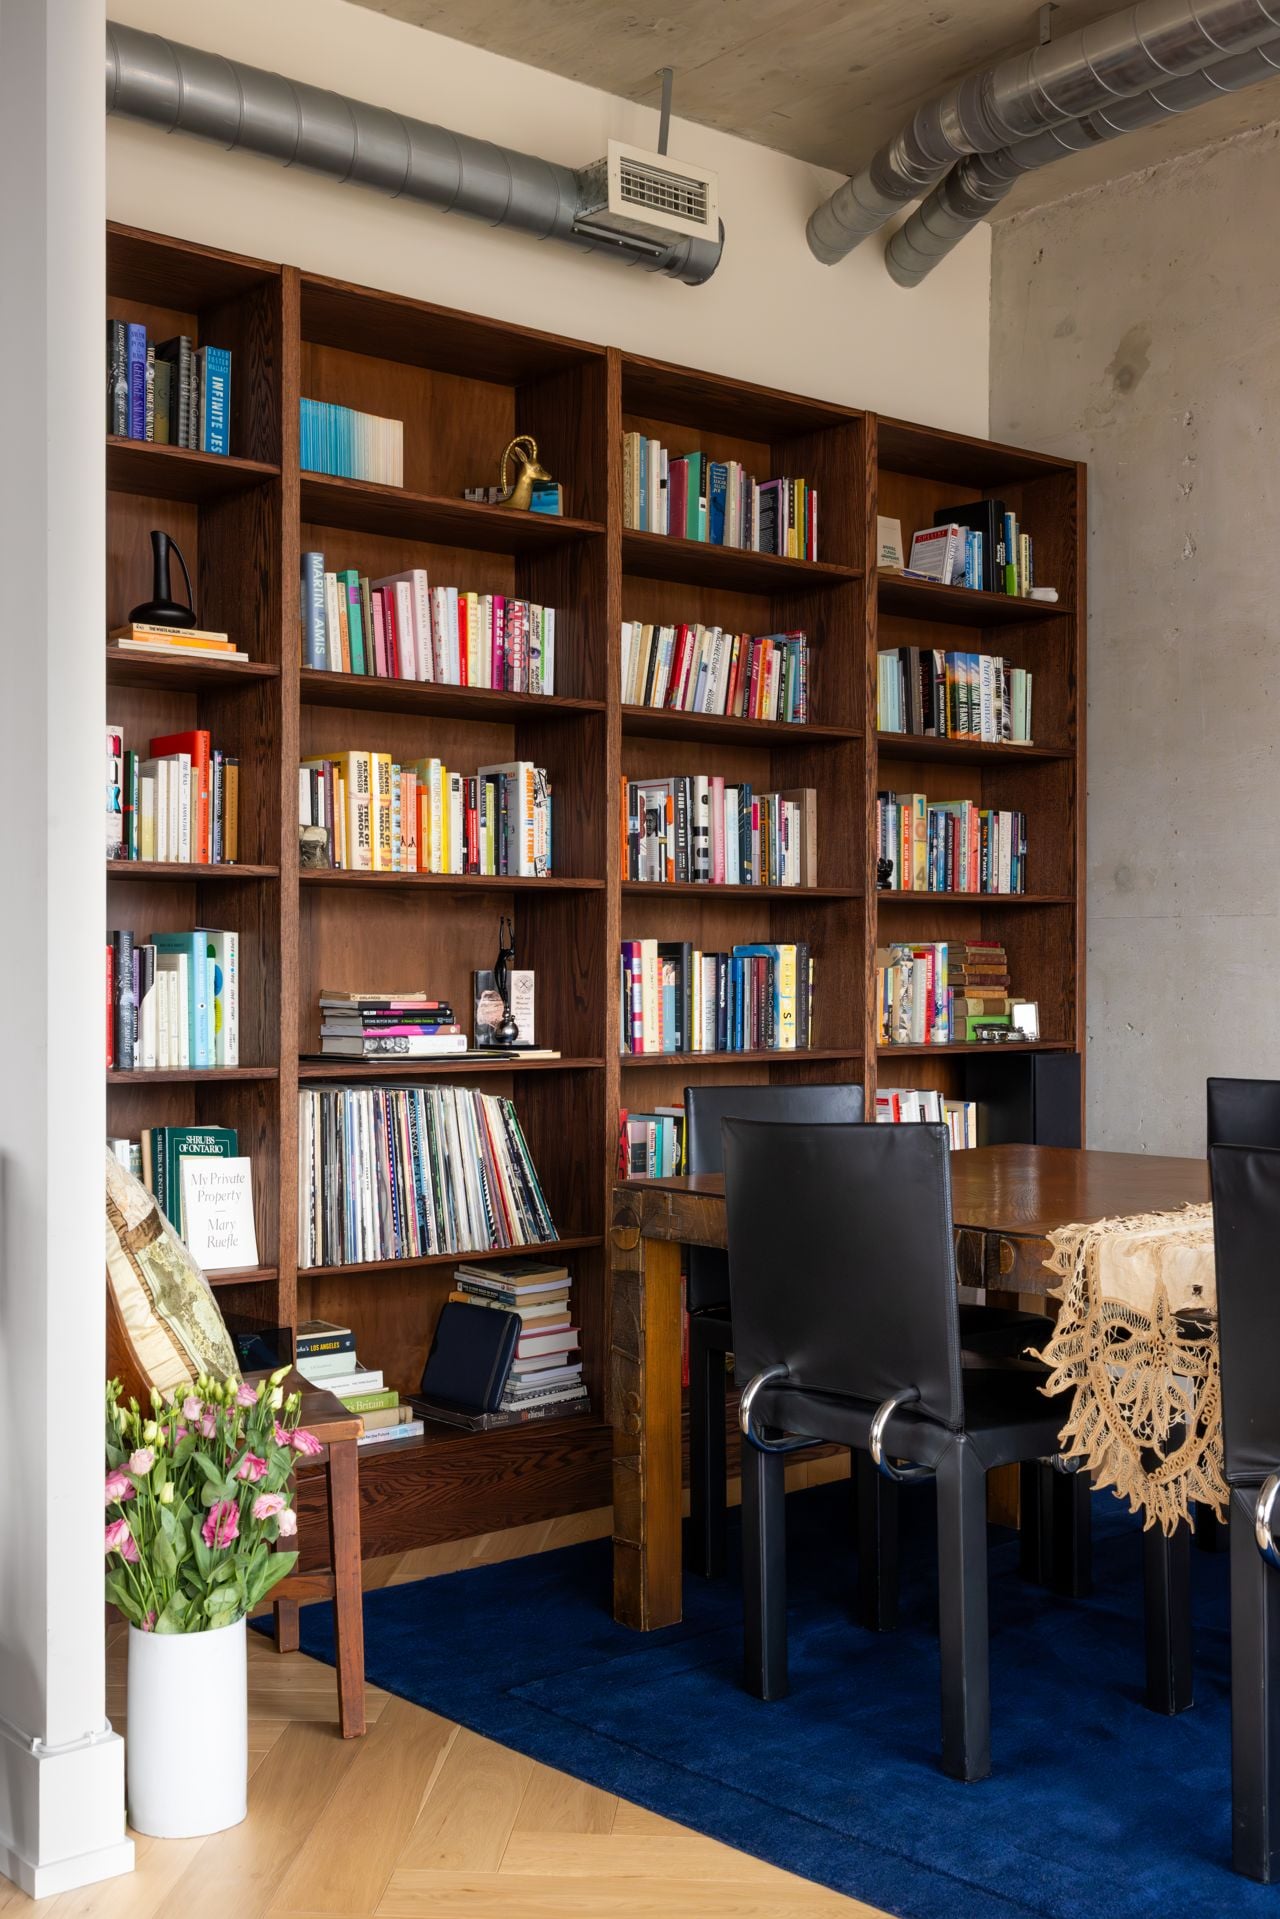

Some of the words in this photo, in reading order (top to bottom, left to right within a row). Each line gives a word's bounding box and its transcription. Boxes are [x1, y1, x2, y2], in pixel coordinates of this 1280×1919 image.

[147, 347, 155, 364] VIGIL
[132, 363, 144, 398] GEORGE
[146, 381, 155, 410] GEORGE
[211, 376, 224, 428] INFINITE
[132, 400, 144, 440] SAUNDER
[146, 411, 154, 442] SAUNDER
[211, 432, 224, 453] JES
[311, 556, 325, 608] MARTIN
[420, 594, 428, 629] BATUMAN
[313, 617, 326, 655] AMIS
[713, 630, 721, 656] RACHEL
[710, 657, 718, 676] CUSK
[746, 642, 754, 677] DAUGHTER
[982, 659, 992, 688] Purity
[959, 704, 969, 734] FRANZEN
[972, 705, 982, 735] FRANZEN
[984, 693, 993, 734] Franzen
[356, 760, 364, 794] JOHNSON
[378, 761, 386, 795] JOHNSON
[526, 768, 535, 819] JONATHAN
[364, 833, 370, 848] OF
[385, 835, 391, 849] OF
[527, 828, 535, 863] LETHEM
[678, 829, 686, 847] BIRD
[123, 935, 131, 962] LINCOLN
[409, 1098, 417, 1126] JOANNA
[178, 1144, 189, 1154] OF
[189, 1144, 223, 1155] ONTARIO
[185, 1135, 215, 1145] SHRUBS
[411, 1126, 419, 1157] NEWSOM
[191, 1173, 209, 1186] My
[209, 1172, 246, 1185] Private
[197, 1189, 243, 1205] Property
[207, 1218, 236, 1233] Mary
[207, 1234, 239, 1249] Ruefle
[310, 1344, 319, 1352] LOS
[319, 1341, 340, 1351] ANGELES
[356, 1399, 384, 1411] Britain
